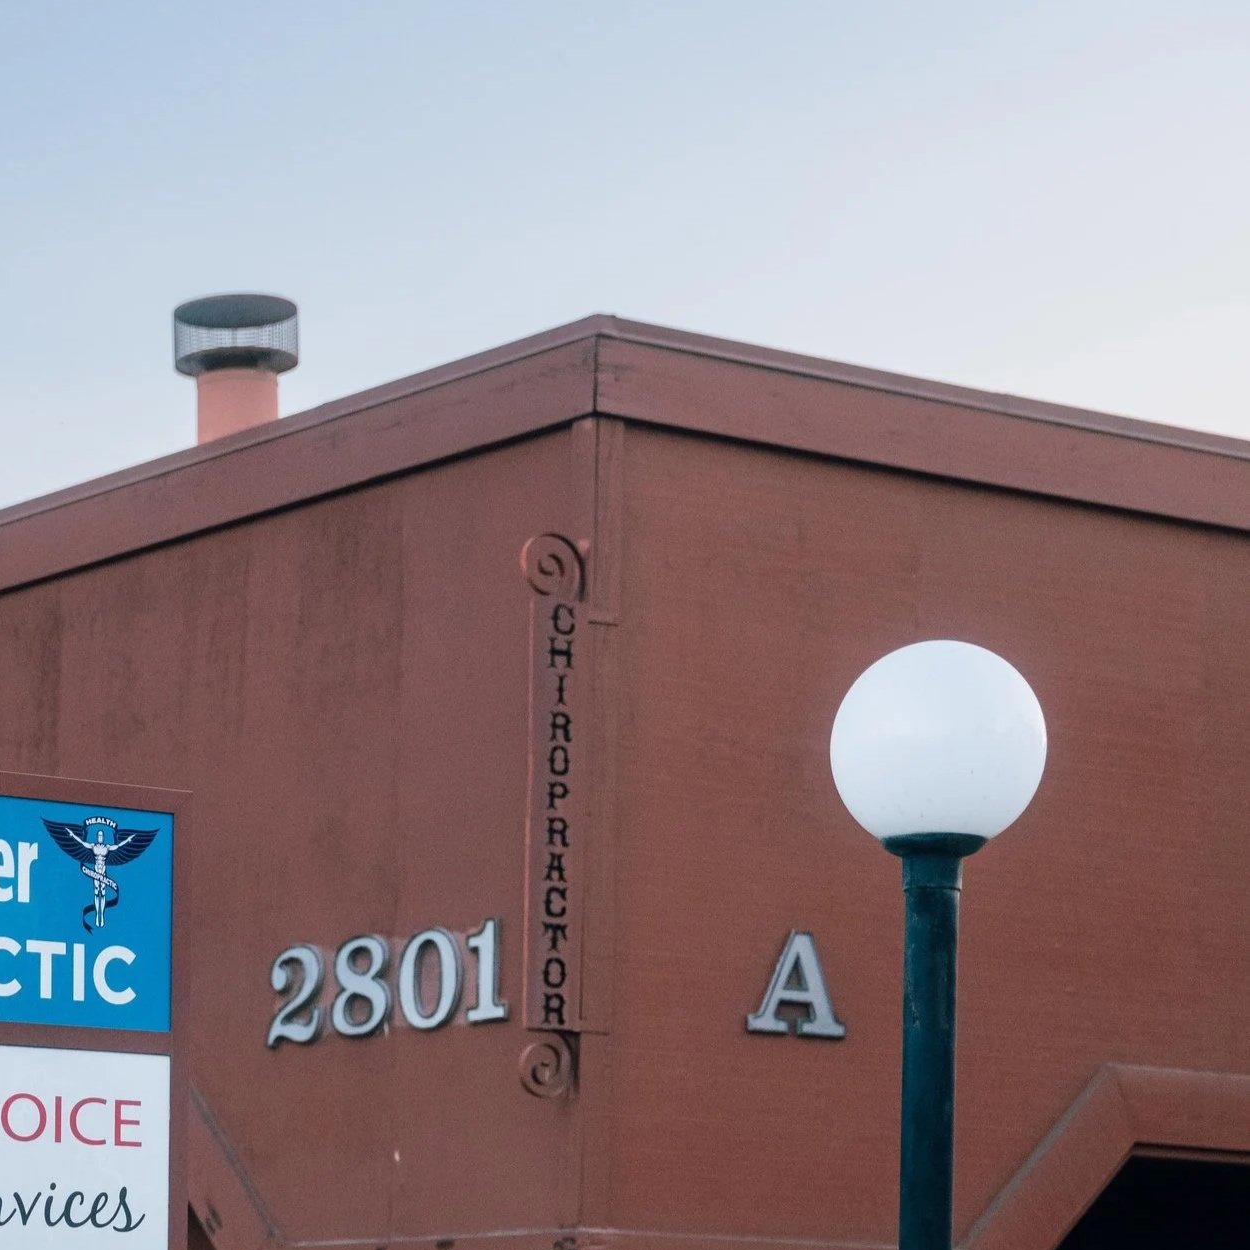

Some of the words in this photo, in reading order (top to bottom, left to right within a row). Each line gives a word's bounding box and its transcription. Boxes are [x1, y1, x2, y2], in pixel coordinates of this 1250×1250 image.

[84, 817, 116, 829] HEALTH
[541, 603, 576, 1025] CHIROPRACTOR
[81, 866, 119, 891] CHIROPRACTIC
[267, 918, 507, 1047] 2801
[747, 930, 846, 1038] A
